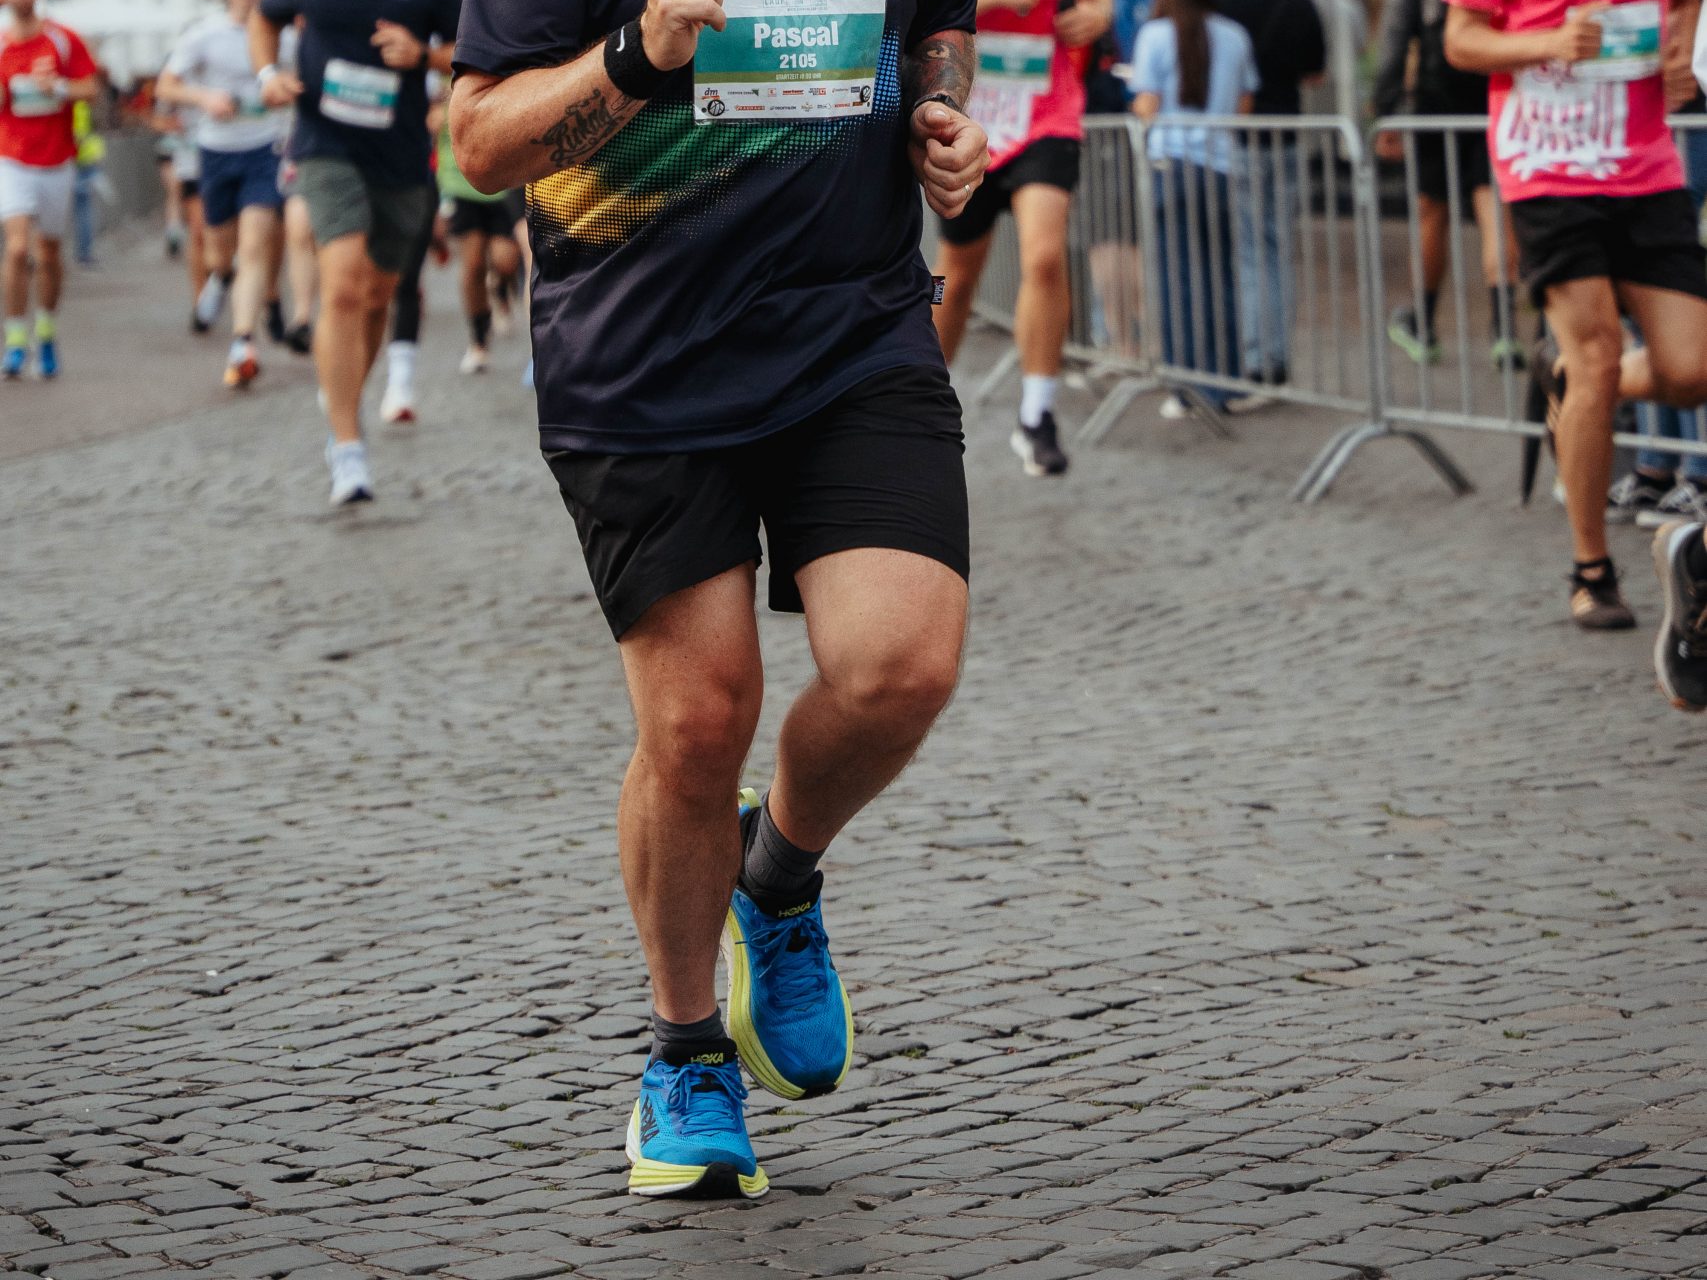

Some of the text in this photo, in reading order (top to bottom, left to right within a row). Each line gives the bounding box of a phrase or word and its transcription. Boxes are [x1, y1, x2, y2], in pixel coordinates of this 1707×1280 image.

[754, 21, 839, 48] Pascal
[780, 53, 817, 68] 2105
[704, 88, 719, 96] dm
[778, 902, 811, 918] HOKA
[690, 1052, 724, 1065] HOKA
